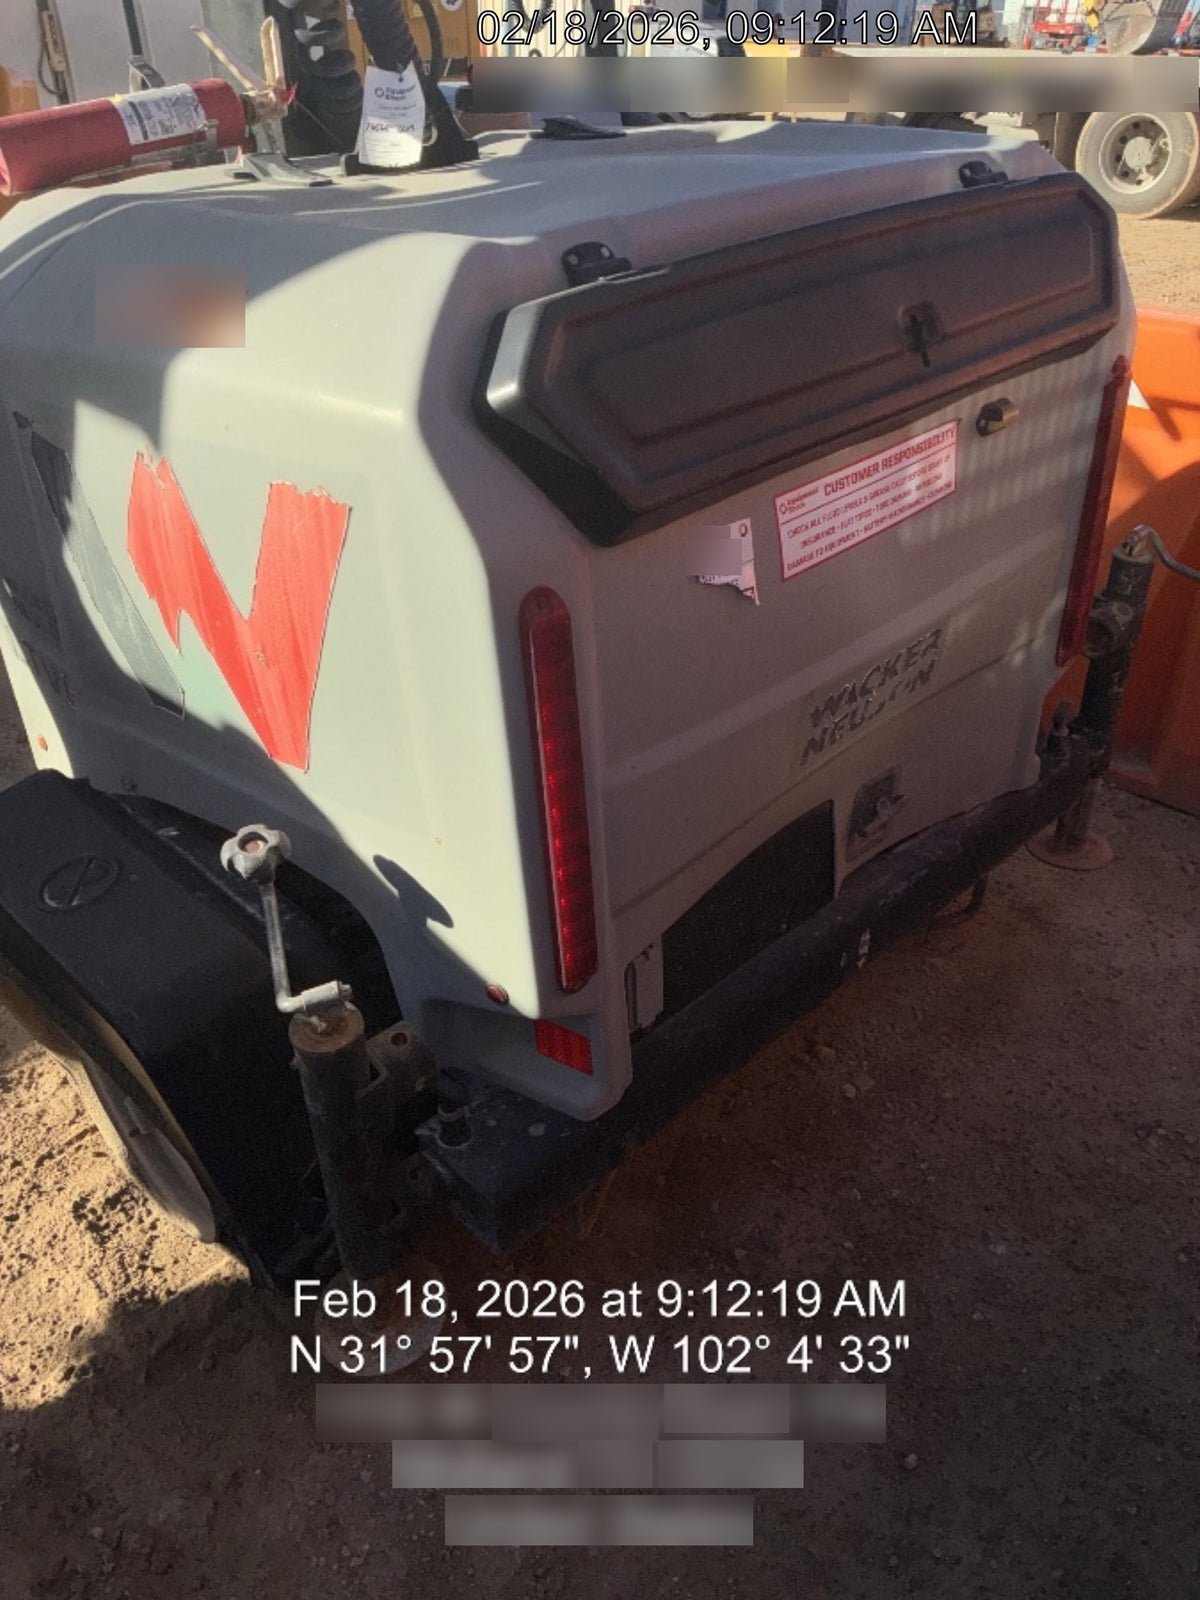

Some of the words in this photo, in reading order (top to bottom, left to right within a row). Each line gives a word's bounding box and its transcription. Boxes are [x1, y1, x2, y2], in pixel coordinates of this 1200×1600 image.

[824, 462, 881, 497] CUSTOMER
[881, 427, 956, 470] RESPONSIBILITY
[810, 629, 942, 729] WACKER
